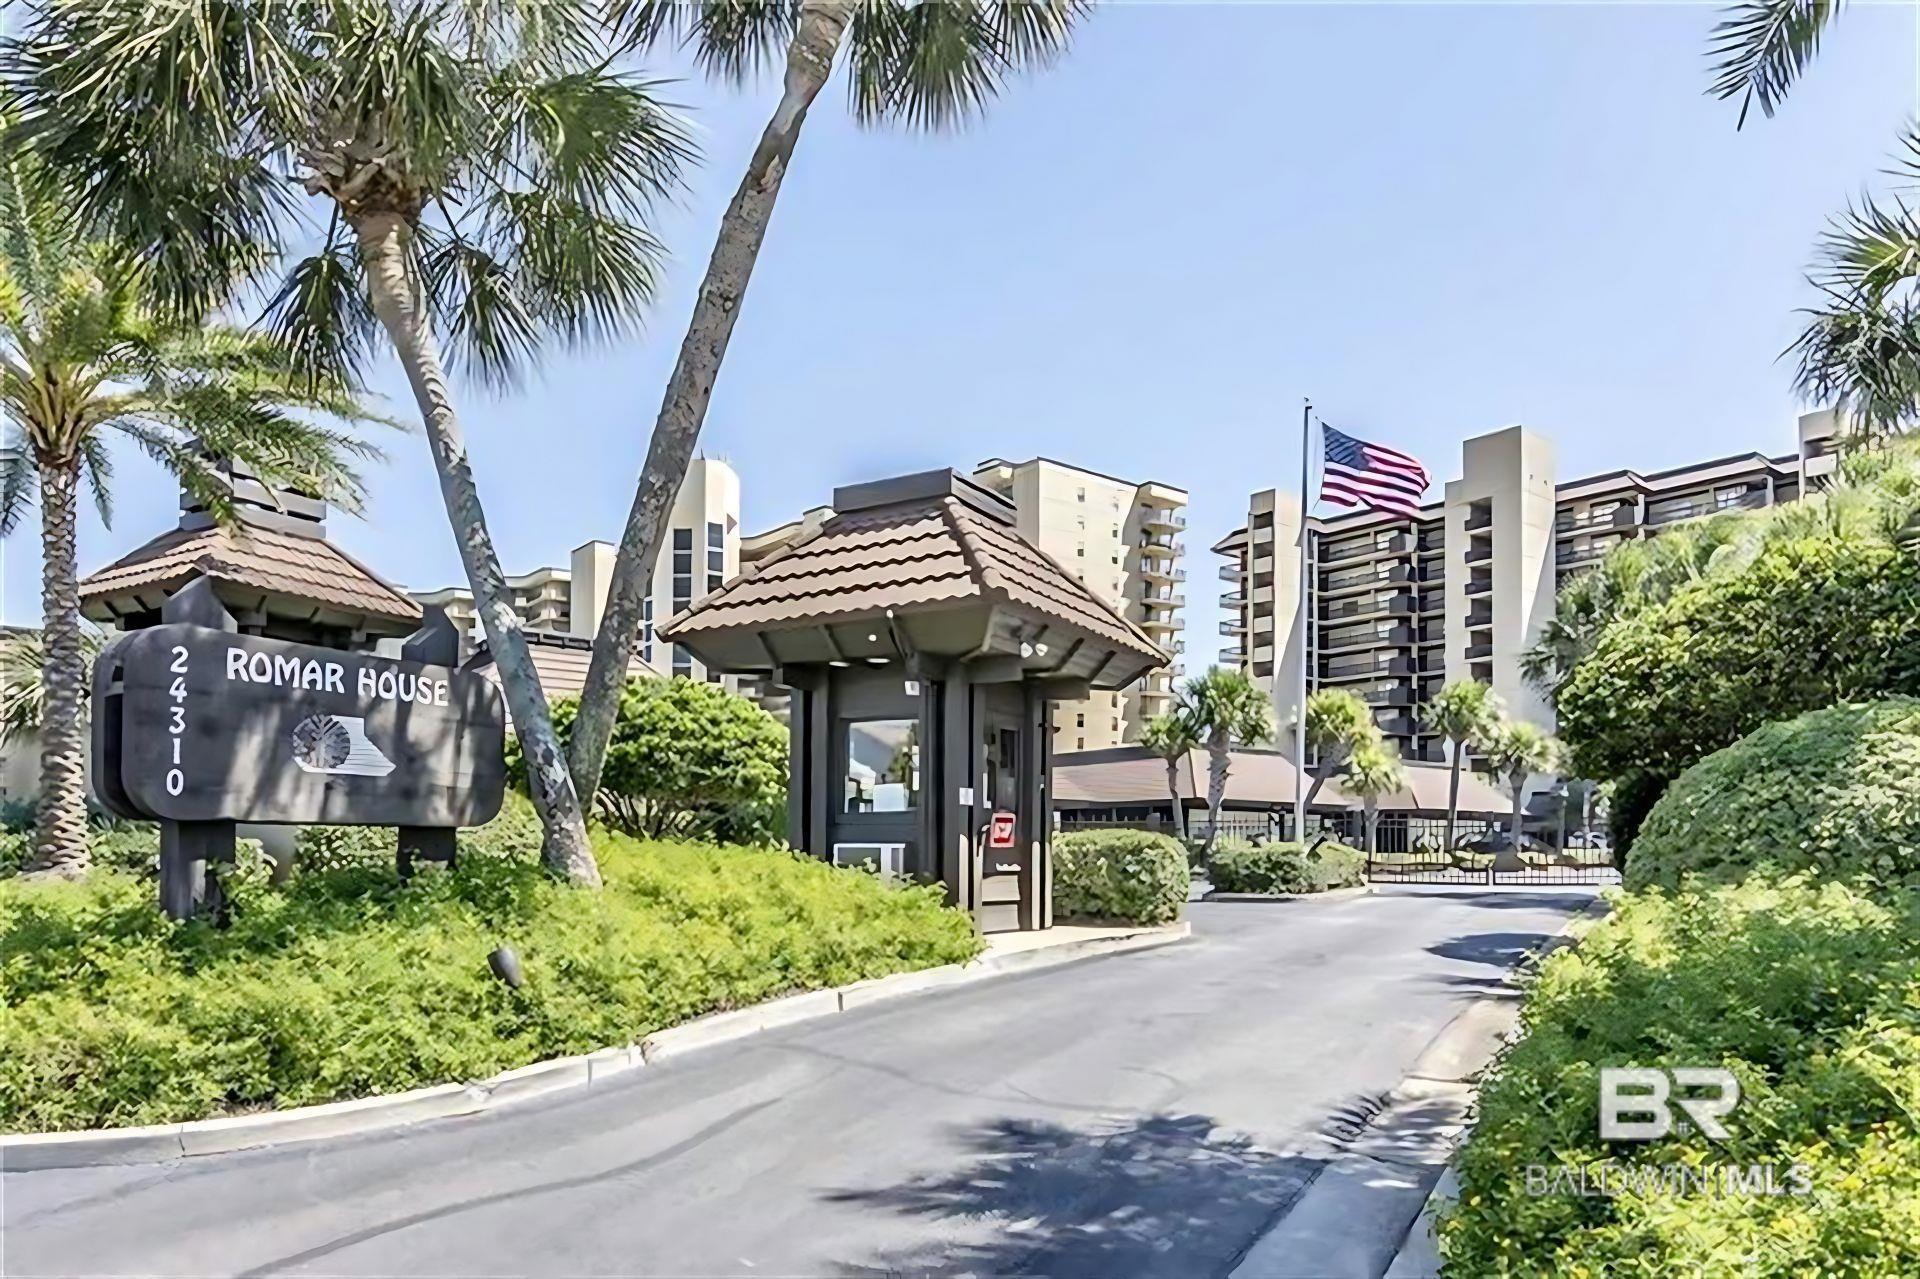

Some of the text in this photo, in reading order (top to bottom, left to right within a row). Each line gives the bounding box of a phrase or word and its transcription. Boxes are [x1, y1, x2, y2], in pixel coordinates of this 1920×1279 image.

[166, 645, 190, 796] 24310
[226, 647, 449, 707] ROMAR HOUSE
